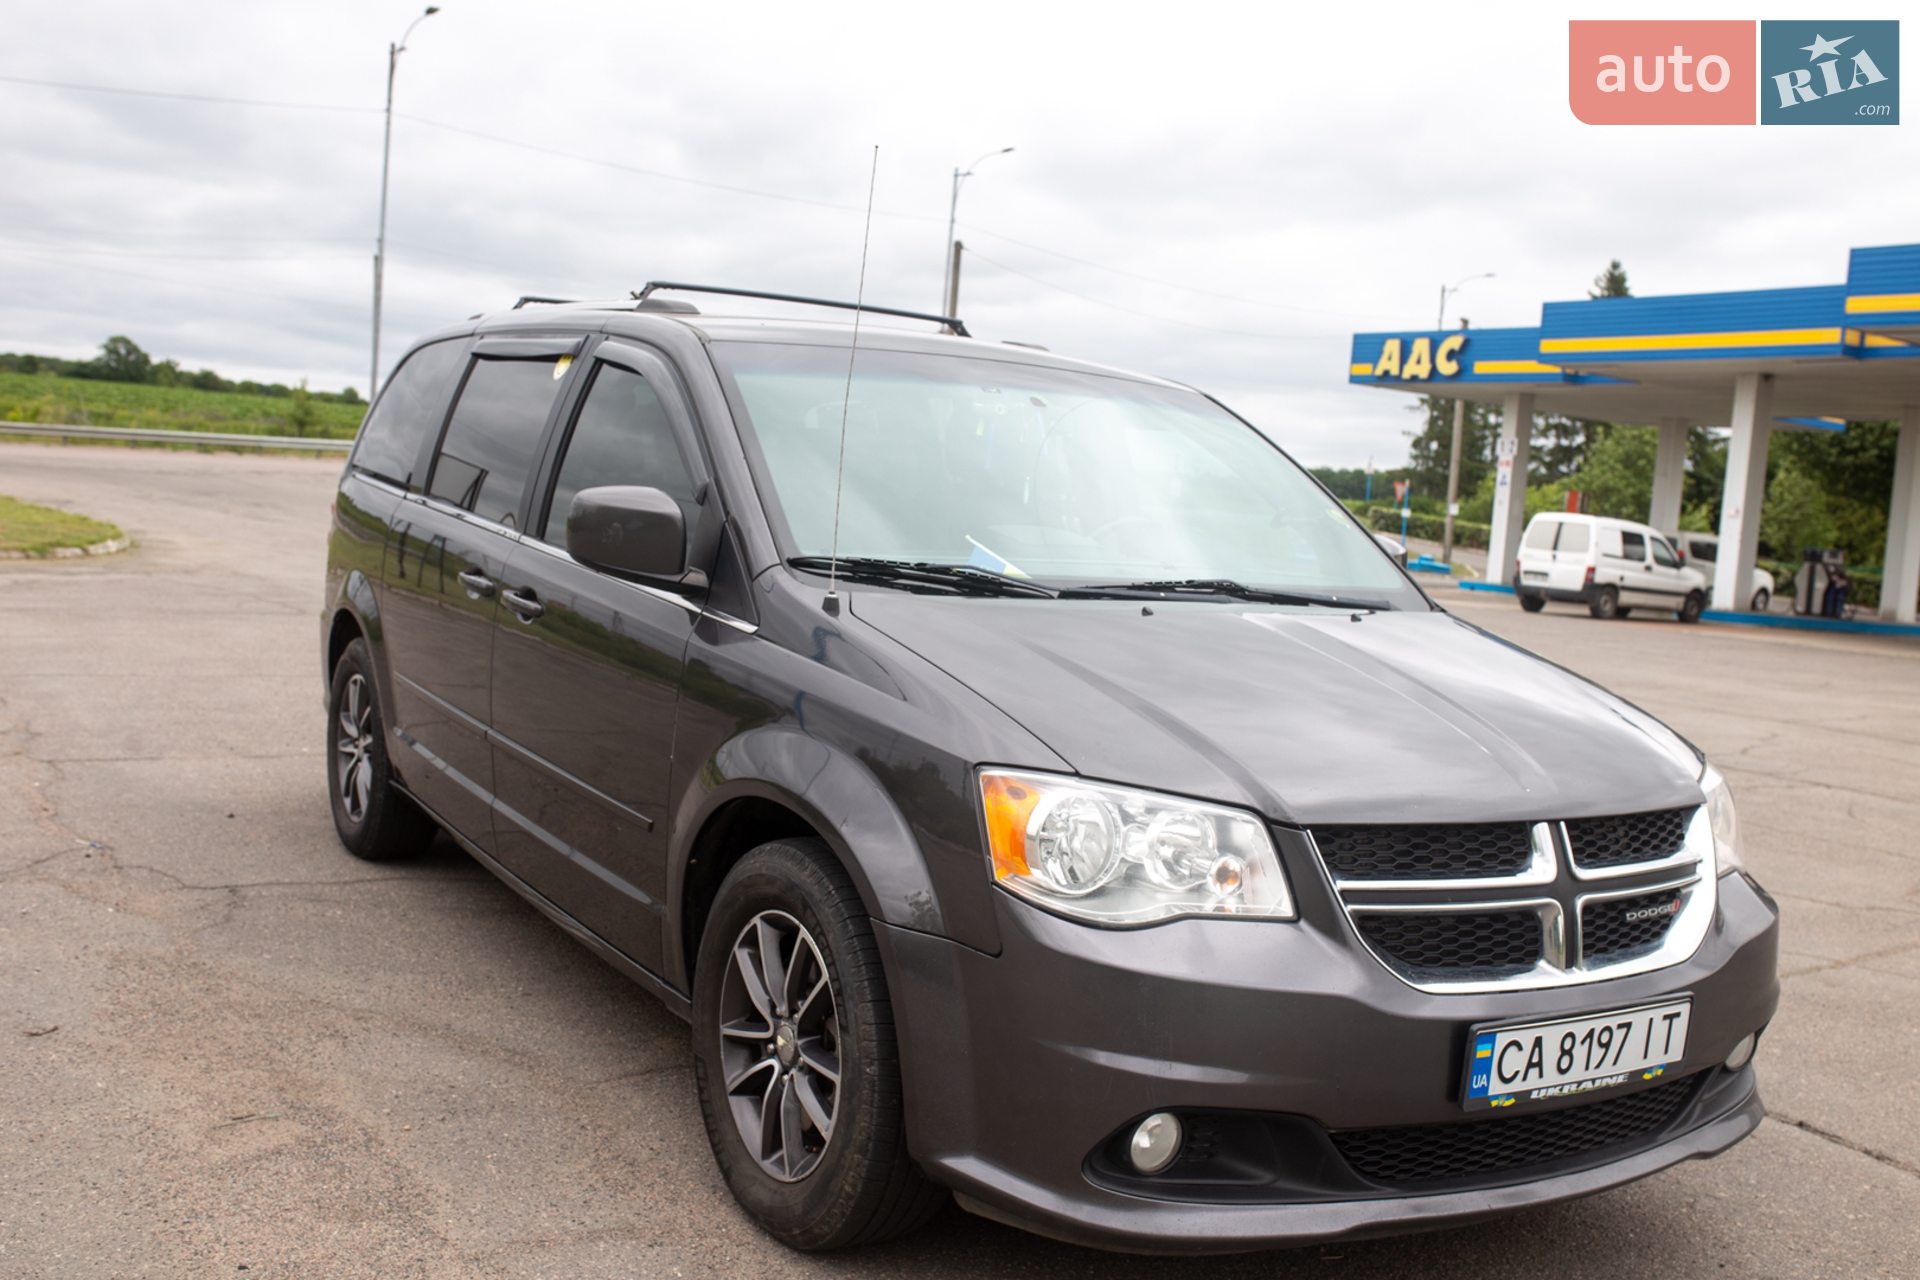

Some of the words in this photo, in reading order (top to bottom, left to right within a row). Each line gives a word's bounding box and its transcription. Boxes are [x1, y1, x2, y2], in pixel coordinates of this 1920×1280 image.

[1374, 335, 1465, 379] АДС
[1626, 903, 1674, 920] DODGE
[1497, 1036, 1543, 1084] CA
[1556, 1021, 1633, 1075] 8197
[1643, 1011, 1682, 1060] IT
[1472, 1074, 1488, 1089] UA
[1530, 1073, 1630, 1099] UKRAINE
